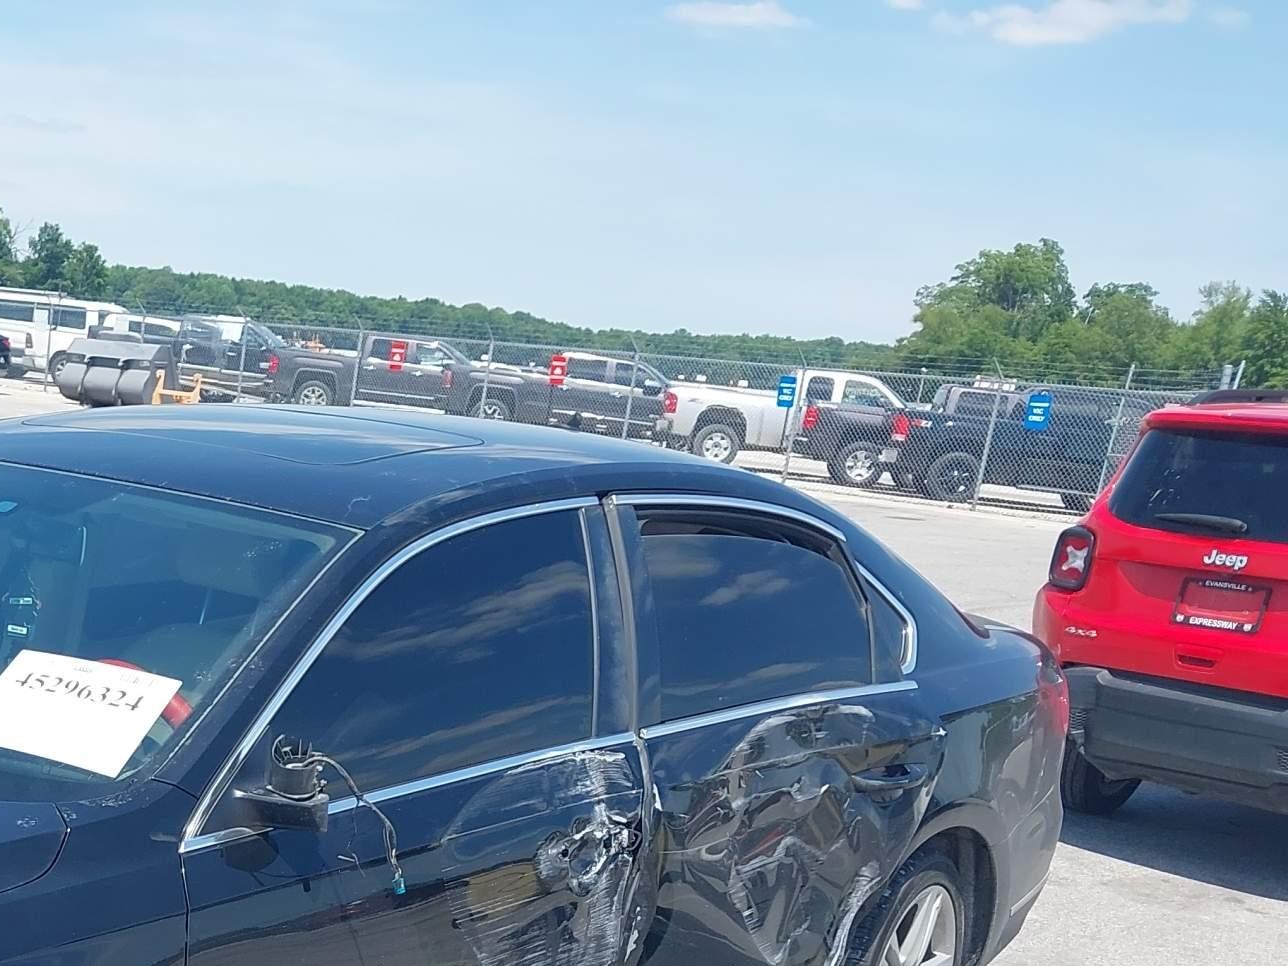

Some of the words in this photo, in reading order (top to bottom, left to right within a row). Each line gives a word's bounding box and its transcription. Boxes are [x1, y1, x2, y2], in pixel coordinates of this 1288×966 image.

[1203, 549, 1249, 570] Jeep
[1205, 580, 1247, 591] EVANSVILLE
[1189, 616, 1238, 630] EXPRESSWAY
[15, 672, 145, 711] 45296324
